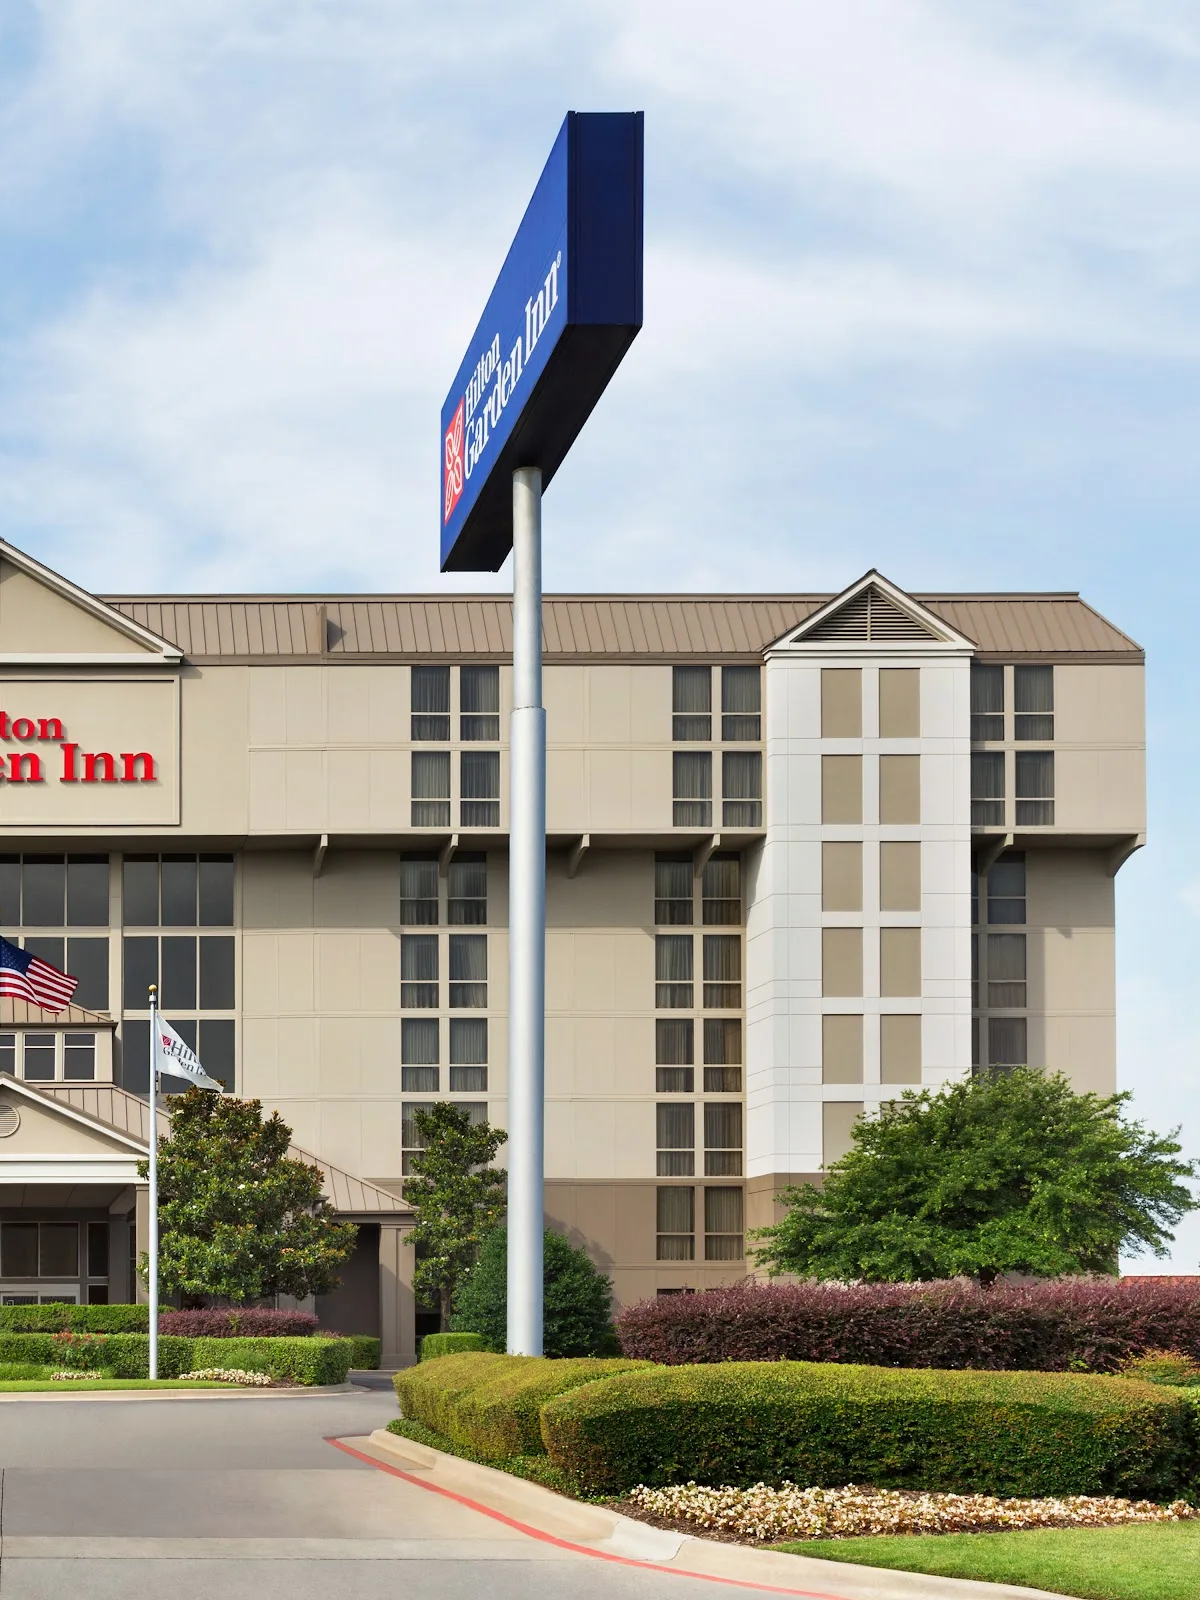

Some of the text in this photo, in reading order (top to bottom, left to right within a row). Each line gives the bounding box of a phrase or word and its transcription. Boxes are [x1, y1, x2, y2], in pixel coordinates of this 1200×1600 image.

[464, 335, 523, 480] Garden
[465, 333, 500, 427] Hilton
[60, 743, 157, 782] Inn
